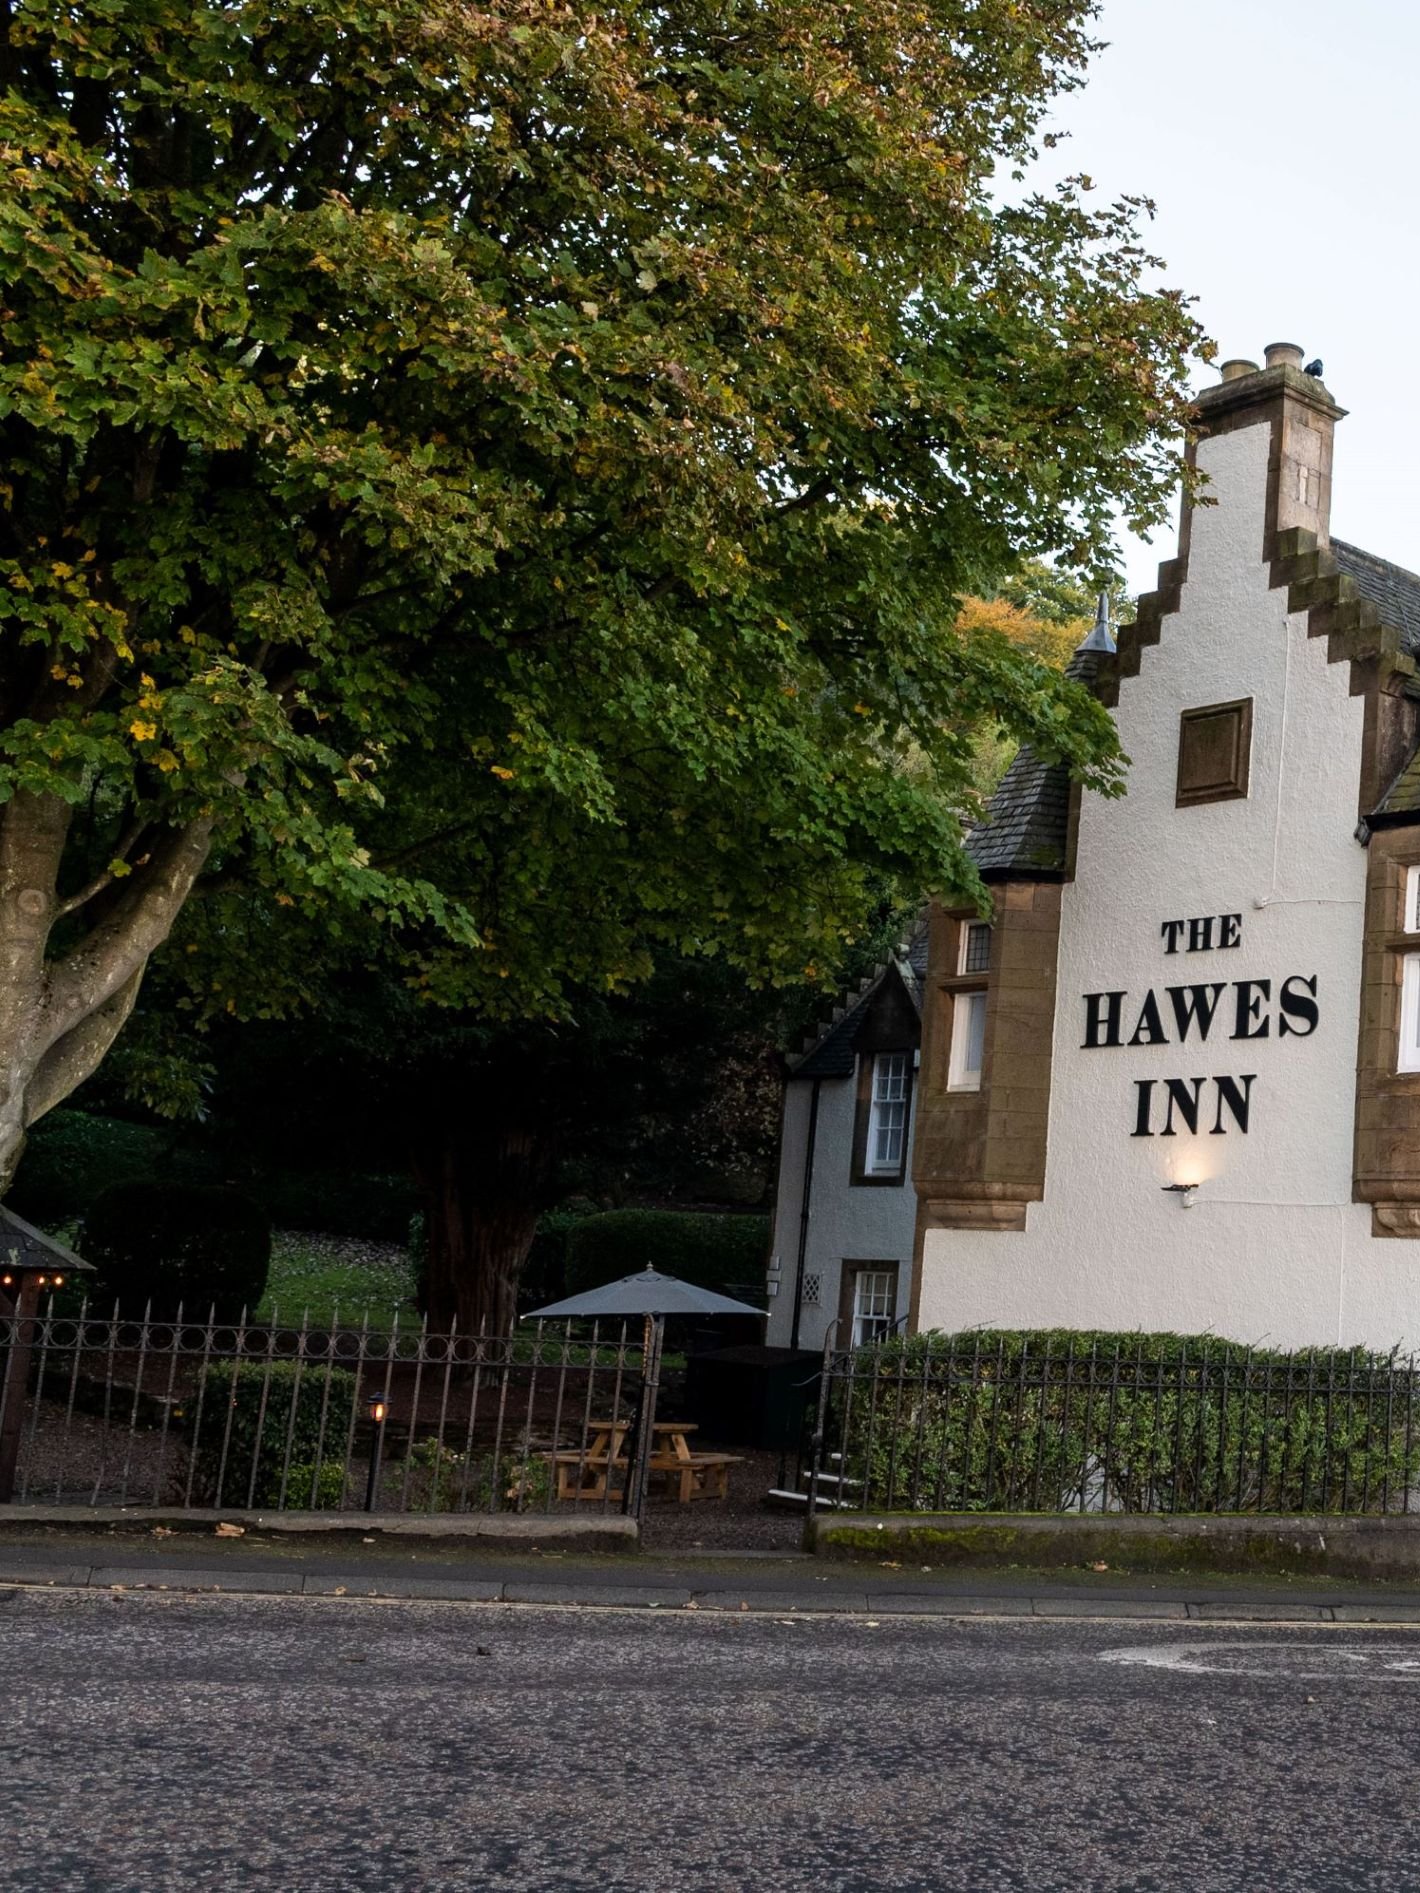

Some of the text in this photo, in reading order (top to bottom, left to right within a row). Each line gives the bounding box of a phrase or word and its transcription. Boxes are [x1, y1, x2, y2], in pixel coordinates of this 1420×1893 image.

[1161, 913, 1242, 954] THE
[1080, 974, 1319, 1049] HAWES
[1130, 1074, 1257, 1137] INN
